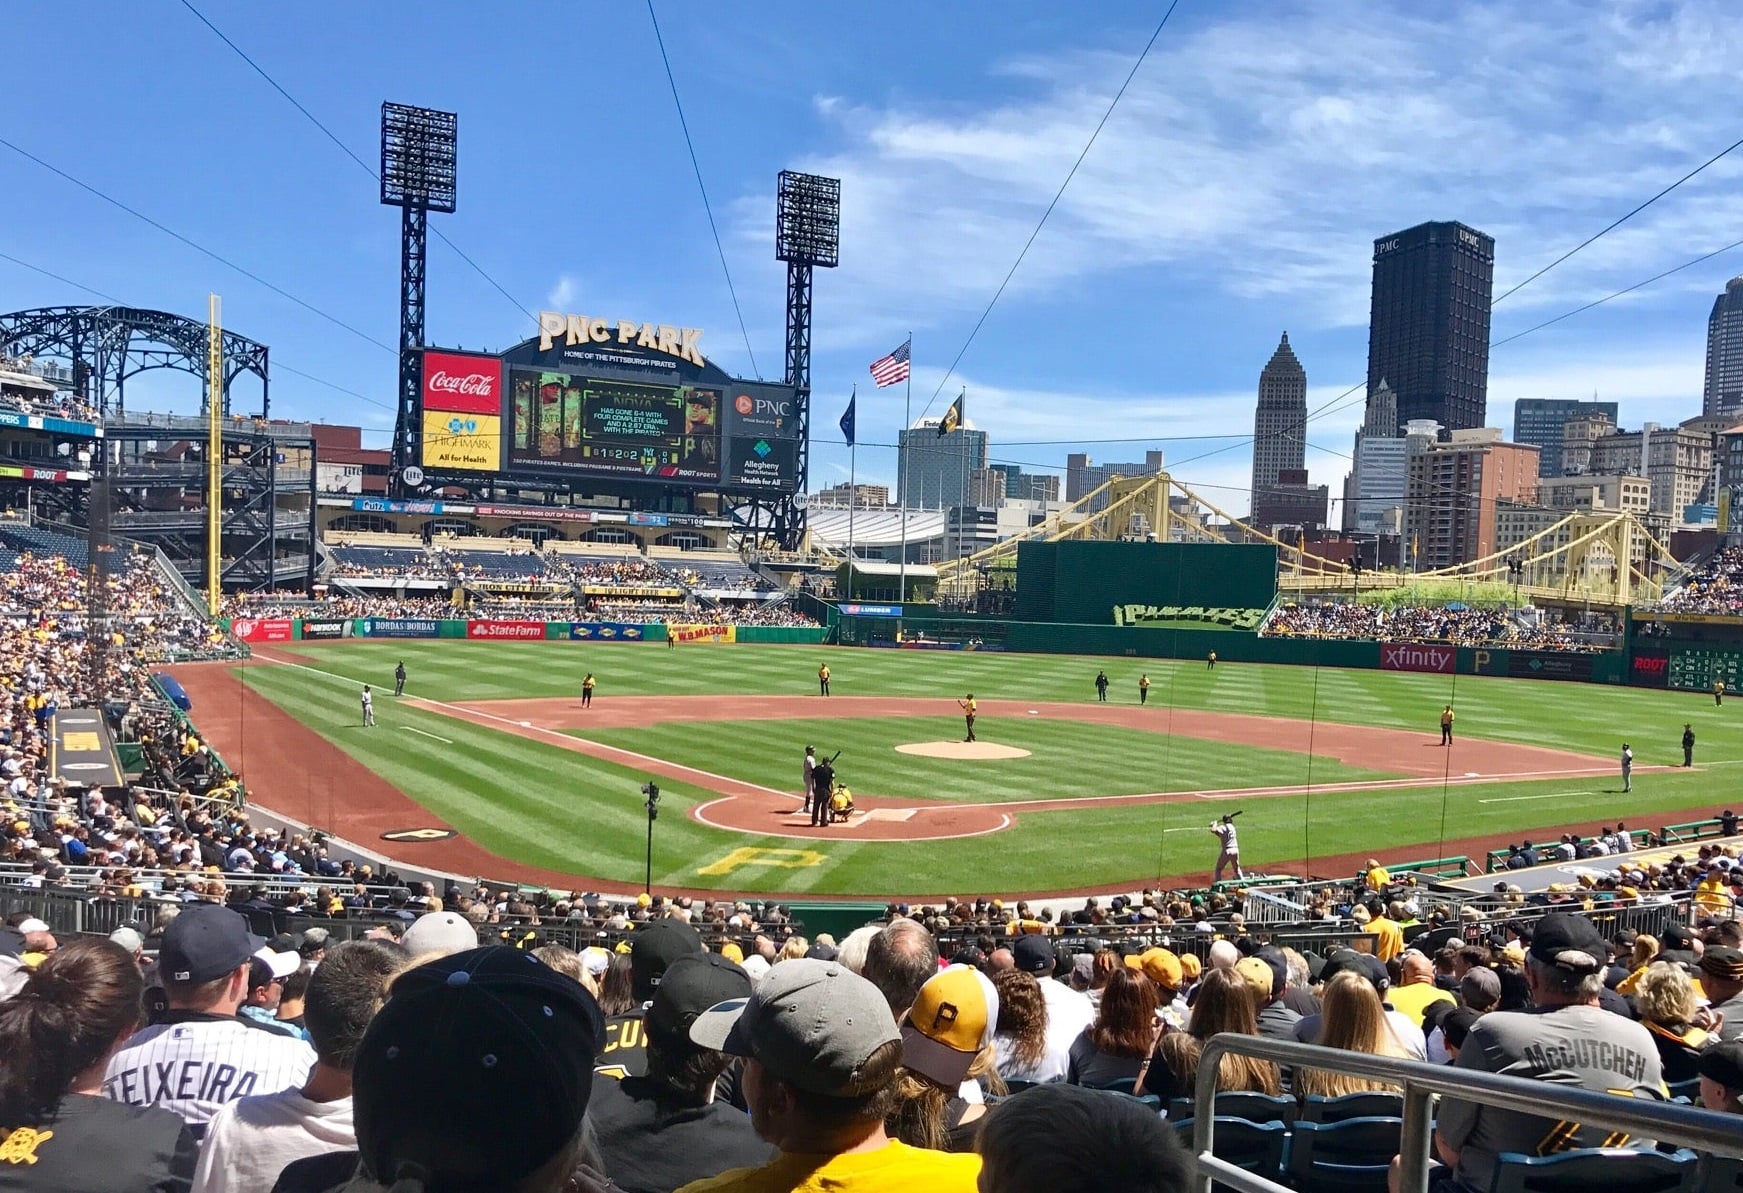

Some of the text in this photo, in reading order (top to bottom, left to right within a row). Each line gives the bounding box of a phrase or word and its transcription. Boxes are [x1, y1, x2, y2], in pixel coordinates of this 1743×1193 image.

[1459, 229, 1480, 248] UPMC
[539, 311, 705, 368] PNC PARK
[564, 350, 583, 359] HOME
[595, 353, 608, 362] THE
[609, 356, 650, 366] PITTSBURGH
[650, 360, 677, 369] PIRATES
[429, 371, 496, 396] Coca-Cola
[600, 407, 614, 415] HAS
[615, 409, 633, 417] GONE
[646, 411, 662, 419] WITH
[754, 399, 790, 416] PNC
[594, 413, 612, 421] FOUR
[612, 415, 645, 424] COMPLETE
[604, 426, 621, 434] WITH
[434, 436, 492, 450] HIGHMARK
[463, 455, 487, 464] Health
[744, 461, 779, 471] Allegheny
[33, 470, 57, 480] ROOT
[678, 469, 696, 477] ROOT
[375, 622, 436, 631] BORDAS BORDAS
[1386, 646, 1450, 670] xfinity
[1474, 650, 1491, 673] P
[1634, 657, 1667, 669] ROOT
[932, 1001, 959, 1030] P
[1524, 1038, 1647, 1083] McCUTCHEN
[103, 1060, 260, 1106] TEIXEIRA
